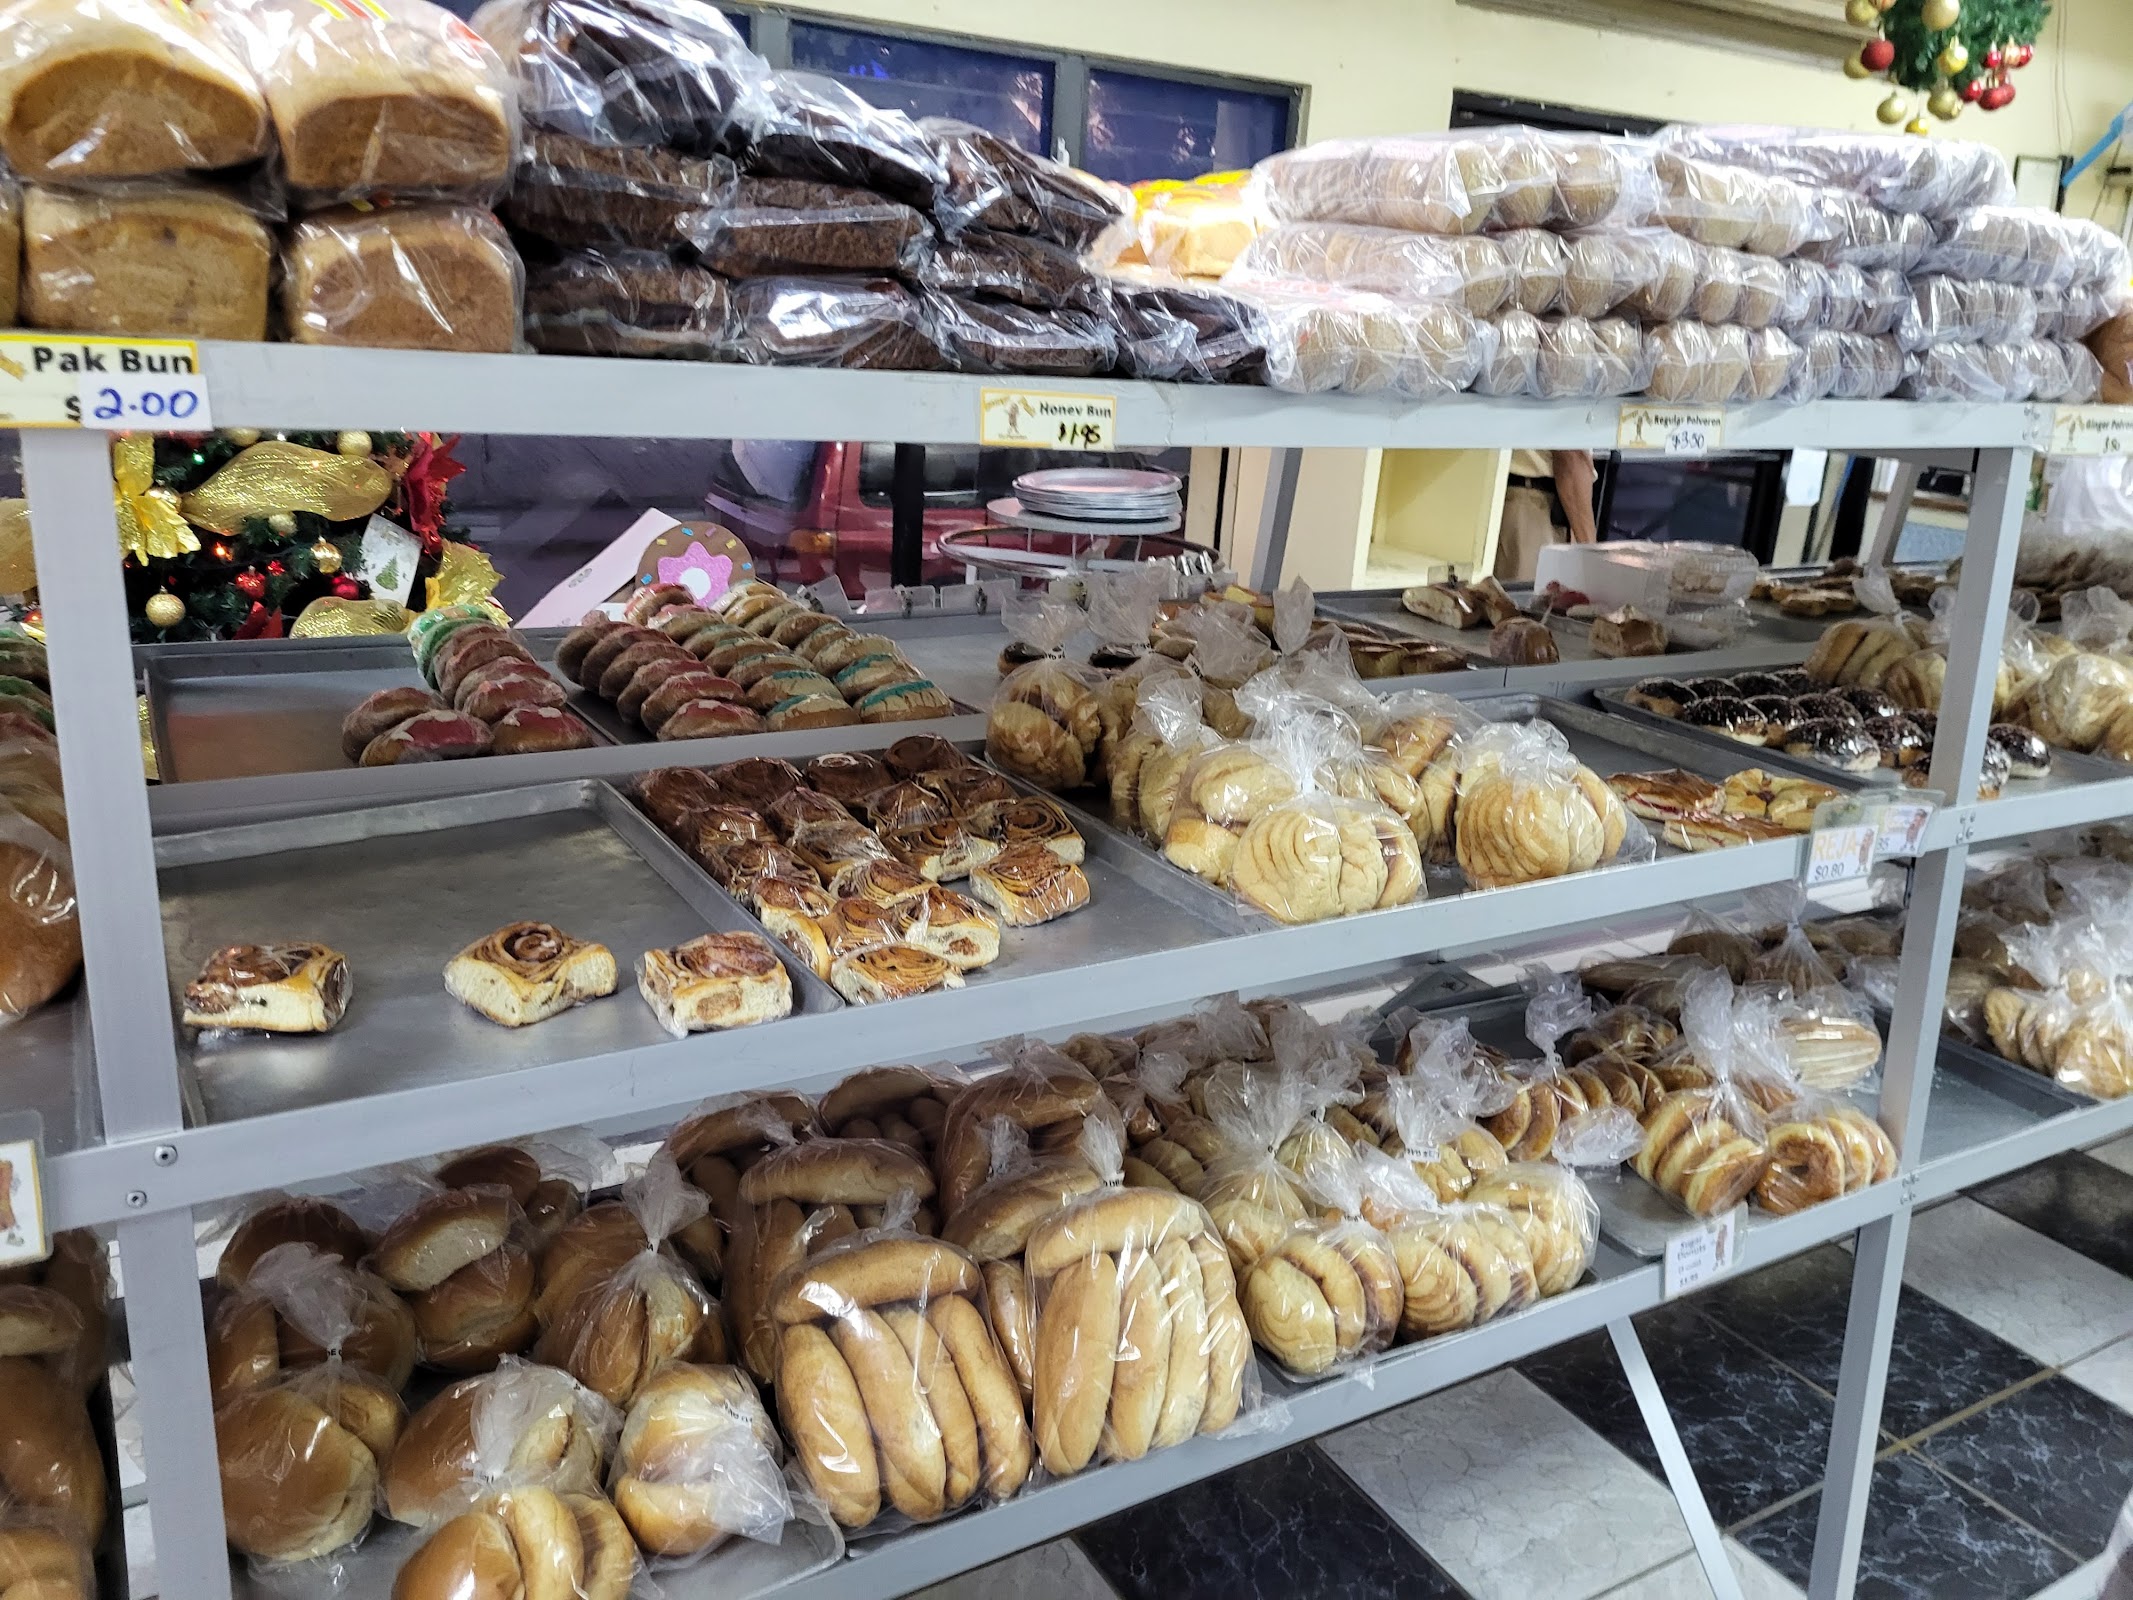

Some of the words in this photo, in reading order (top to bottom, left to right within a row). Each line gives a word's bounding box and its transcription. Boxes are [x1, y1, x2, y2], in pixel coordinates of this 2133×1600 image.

[33, 346, 107, 373] Pak
[120, 348, 193, 374] Bun
[94, 387, 199, 420] 2.00
[1087, 404, 1112, 419] Bun
[1654, 414, 1684, 428] Regular
